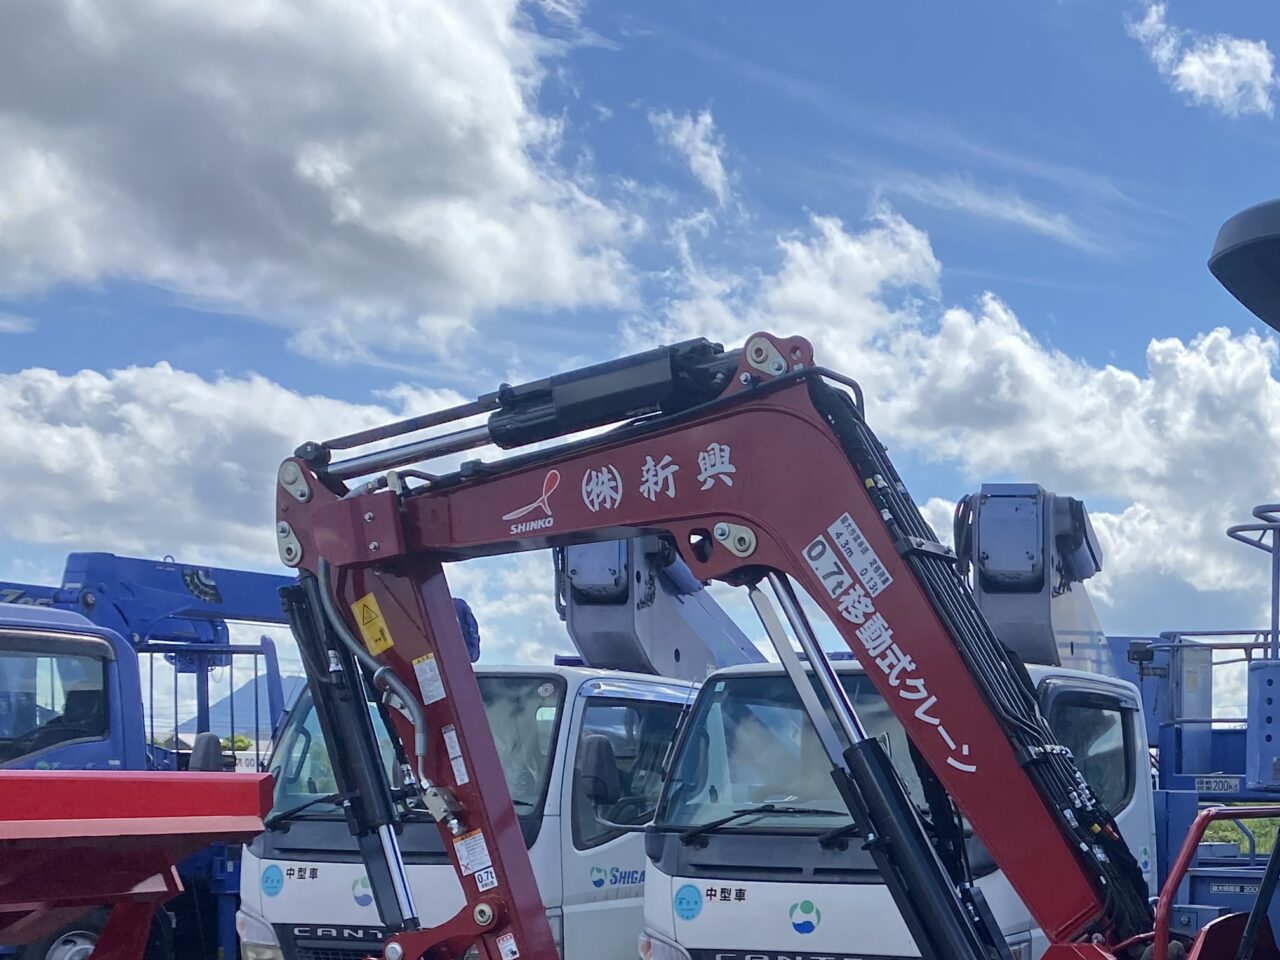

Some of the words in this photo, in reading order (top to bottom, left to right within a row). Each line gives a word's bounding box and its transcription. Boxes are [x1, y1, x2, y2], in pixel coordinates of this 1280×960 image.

[509, 517, 554, 535] SHINKO
[834, 531, 854, 558] 4.3m
[859, 567, 880, 596] 0.13t
[286, 867, 319, 880] 中型車
[477, 870, 495, 884] 0.7t
[705, 887, 747, 902] 中型車
[293, 927, 384, 939] CANT
